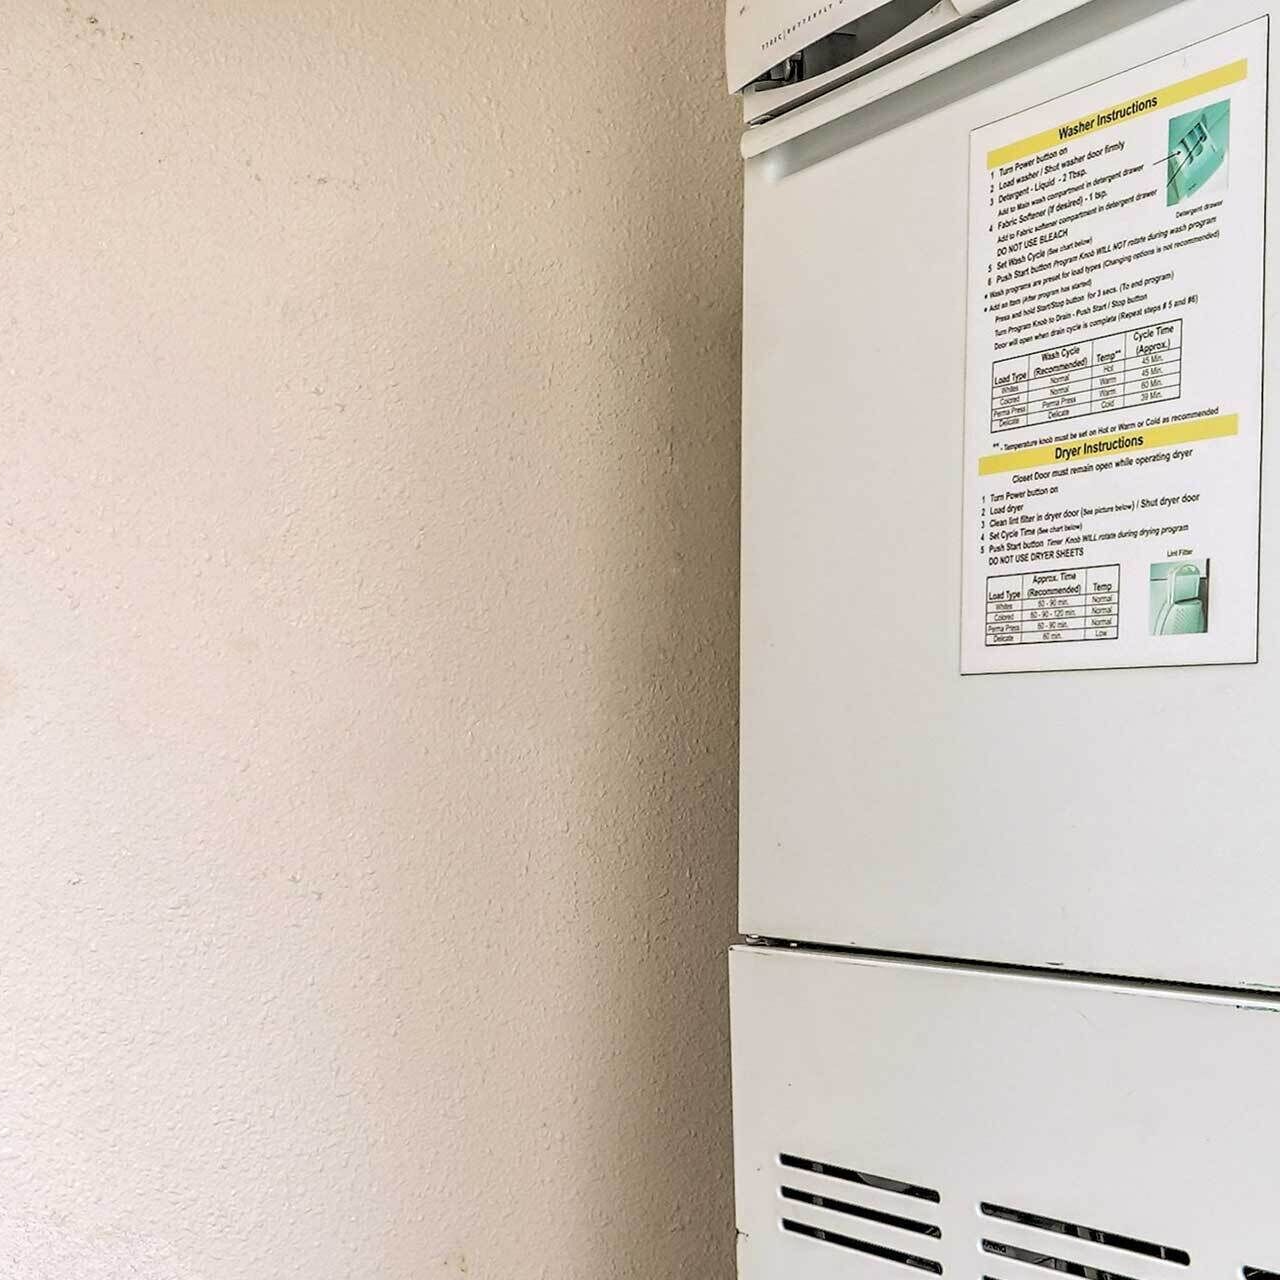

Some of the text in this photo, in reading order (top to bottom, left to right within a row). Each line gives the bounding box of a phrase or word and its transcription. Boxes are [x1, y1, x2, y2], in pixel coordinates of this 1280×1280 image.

[1059, 97, 1157, 139] Washer Instructions
[999, 147, 1067, 176] Turn Power button on
[999, 141, 1125, 190] Load washer washer door firmly
[998, 177, 1055, 203] Detergent Liquid
[1135, 189, 1157, 201] drawer
[998, 217, 1017, 229] Fabric
[996, 272, 1012, 283] Push
[1014, 267, 1029, 278] Start
[1030, 262, 1051, 274] button
[1187, 217, 1216, 231] program
[997, 228, 1068, 257] DO NOT USE BLEACH
[996, 260, 1007, 270] Set
[1027, 249, 1045, 262] Cycle
[1133, 326, 1174, 342] Cycle Time
[1061, 346, 1080, 358] Cycle
[1136, 339, 1170, 355] (Approx.)
[1033, 357, 1087, 378] (Recommended)
[994, 372, 1026, 385] Load Type
[1145, 417, 1160, 426] Cold
[1171, 406, 1219, 421] recommended
[1055, 436, 1143, 460] Dryer Instructions
[1012, 449, 1192, 483] Closet Door must remain open while operating dryer
[990, 493, 1004, 502] Turn
[1005, 491, 1025, 500] Power
[1027, 488, 1048, 497] button
[989, 519, 1007, 527] Clean
[1020, 515, 1035, 523] filter
[1044, 512, 1062, 522] dryer
[1063, 509, 1079, 518] door
[1140, 498, 1158, 508] Shut
[1159, 496, 1180, 506] dryer
[1181, 494, 1199, 503] door
[990, 504, 1023, 515] Load dryer
[989, 531, 999, 540] Set
[1001, 530, 1018, 540] Cycle
[1020, 527, 1035, 536] Time
[989, 544, 1004, 552] Push
[1006, 542, 1021, 551] Start
[1022, 540, 1043, 549] button
[1117, 529, 1138, 538] during
[1139, 528, 1159, 537] drying
[1160, 524, 1188, 535] program
[988, 547, 1083, 565] DO NOT USE DRYER SHEETS
[1032, 572, 1076, 584] Approx. Time
[988, 590, 1020, 600] Load Type
[1027, 584, 1081, 599] (Recommended)
[1093, 582, 1112, 594] Temp
[1092, 595, 1112, 603] Normal
[994, 613, 1014, 621] Colored
[1091, 606, 1112, 614] Normal
[1091, 617, 1112, 625] Normal
[993, 634, 1013, 642] Delicate
[1095, 627, 1108, 636] Low
